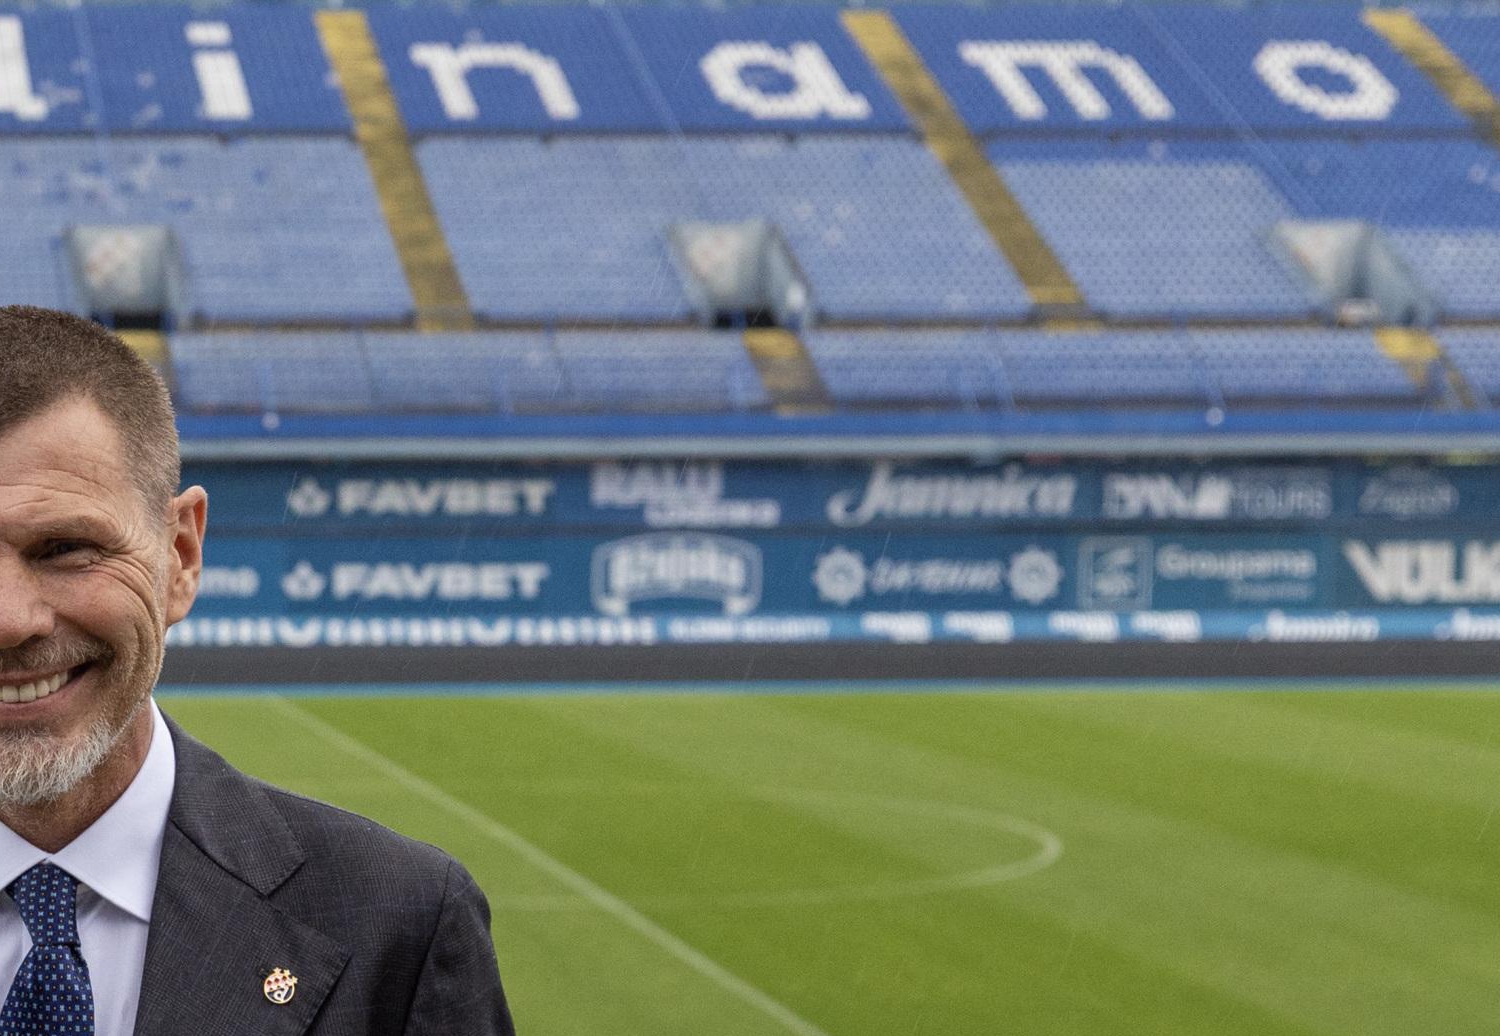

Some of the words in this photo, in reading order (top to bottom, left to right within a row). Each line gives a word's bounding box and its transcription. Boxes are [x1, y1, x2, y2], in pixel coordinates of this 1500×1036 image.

[336, 478, 555, 516] FAVBET
[827, 461, 1077, 527] Jamnica
[332, 562, 551, 600] FAVBET
[1157, 545, 1316, 581] Groupama
